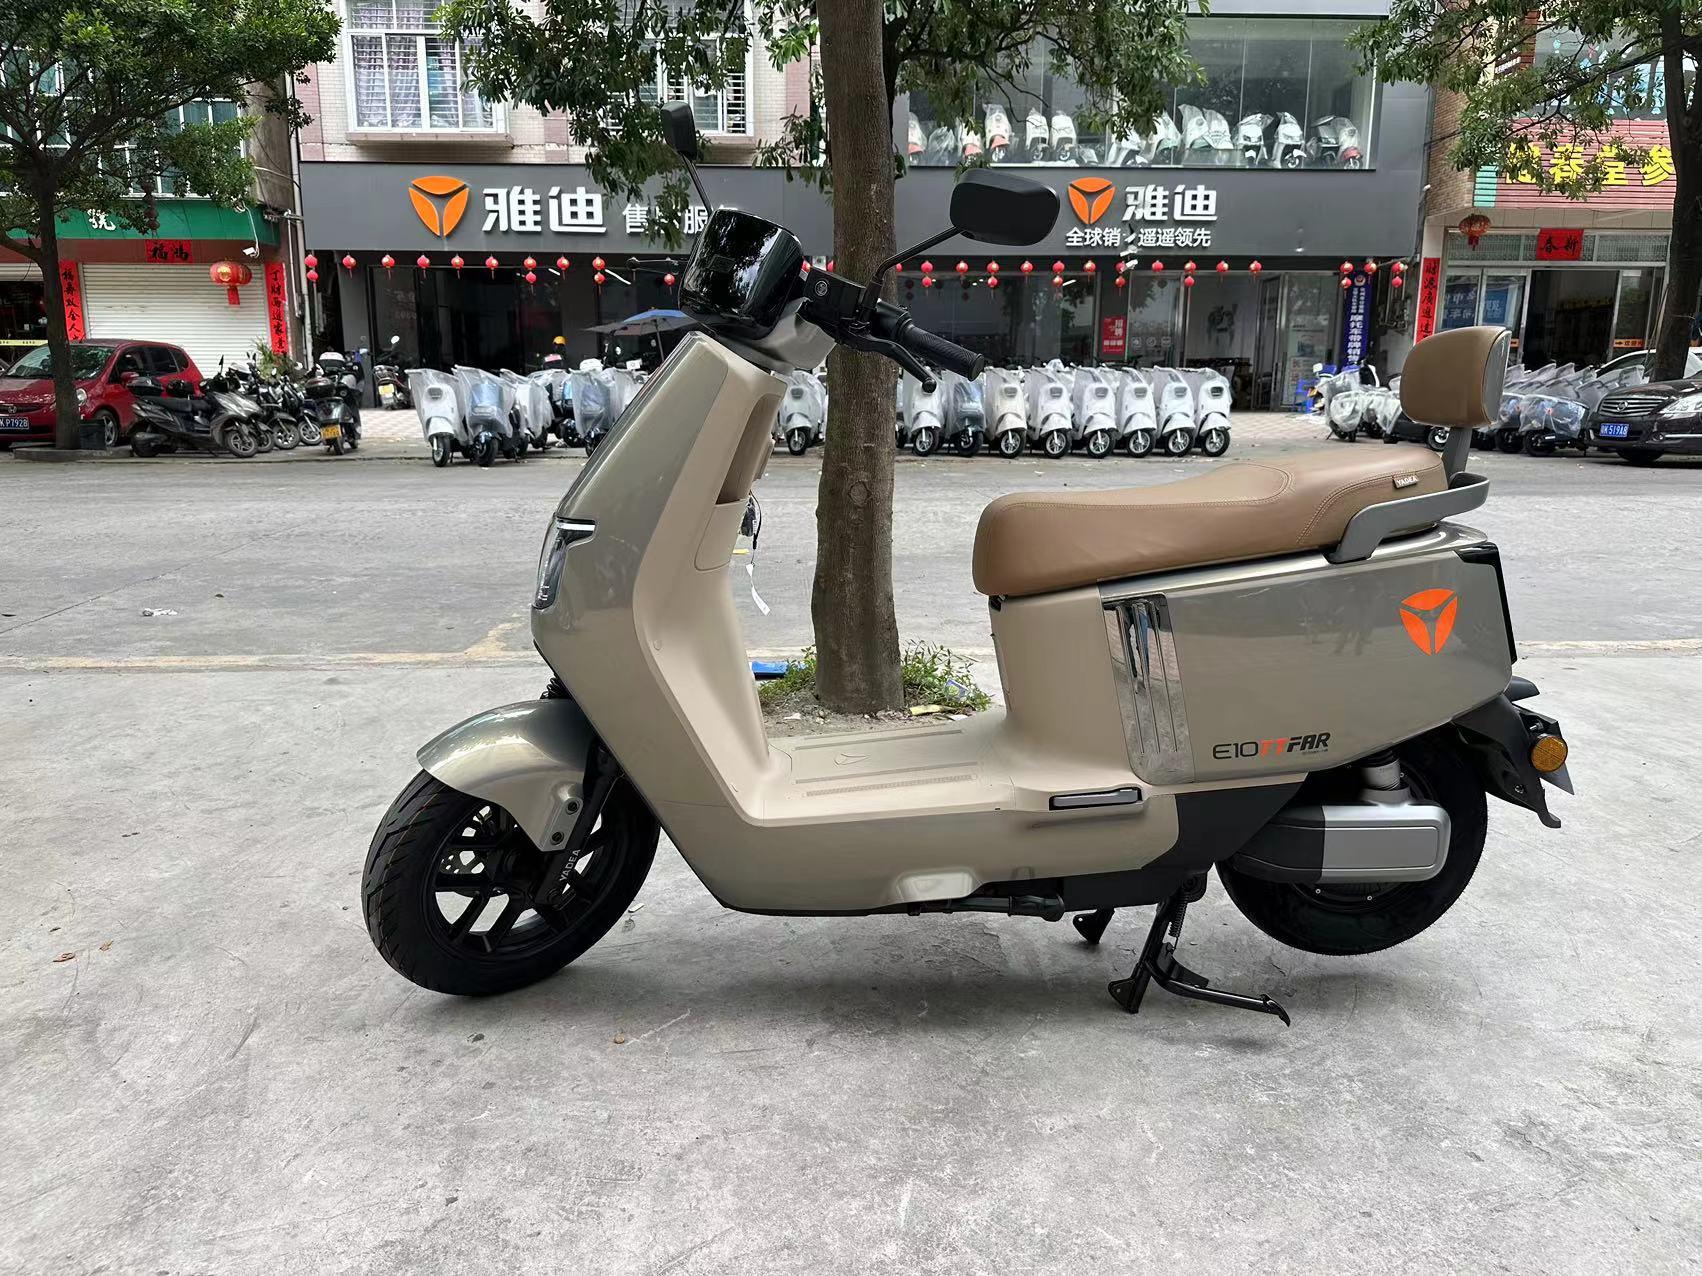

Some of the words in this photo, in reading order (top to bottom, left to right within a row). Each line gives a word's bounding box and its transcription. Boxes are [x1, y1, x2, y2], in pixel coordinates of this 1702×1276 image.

[482, 186, 607, 232] 雅迪
[622, 203, 738, 234] 售服
[1122, 184, 1218, 221] 雅迪
[1065, 227, 1212, 248] 全球销遥遥领先
[559, 849, 581, 881] YADEA
